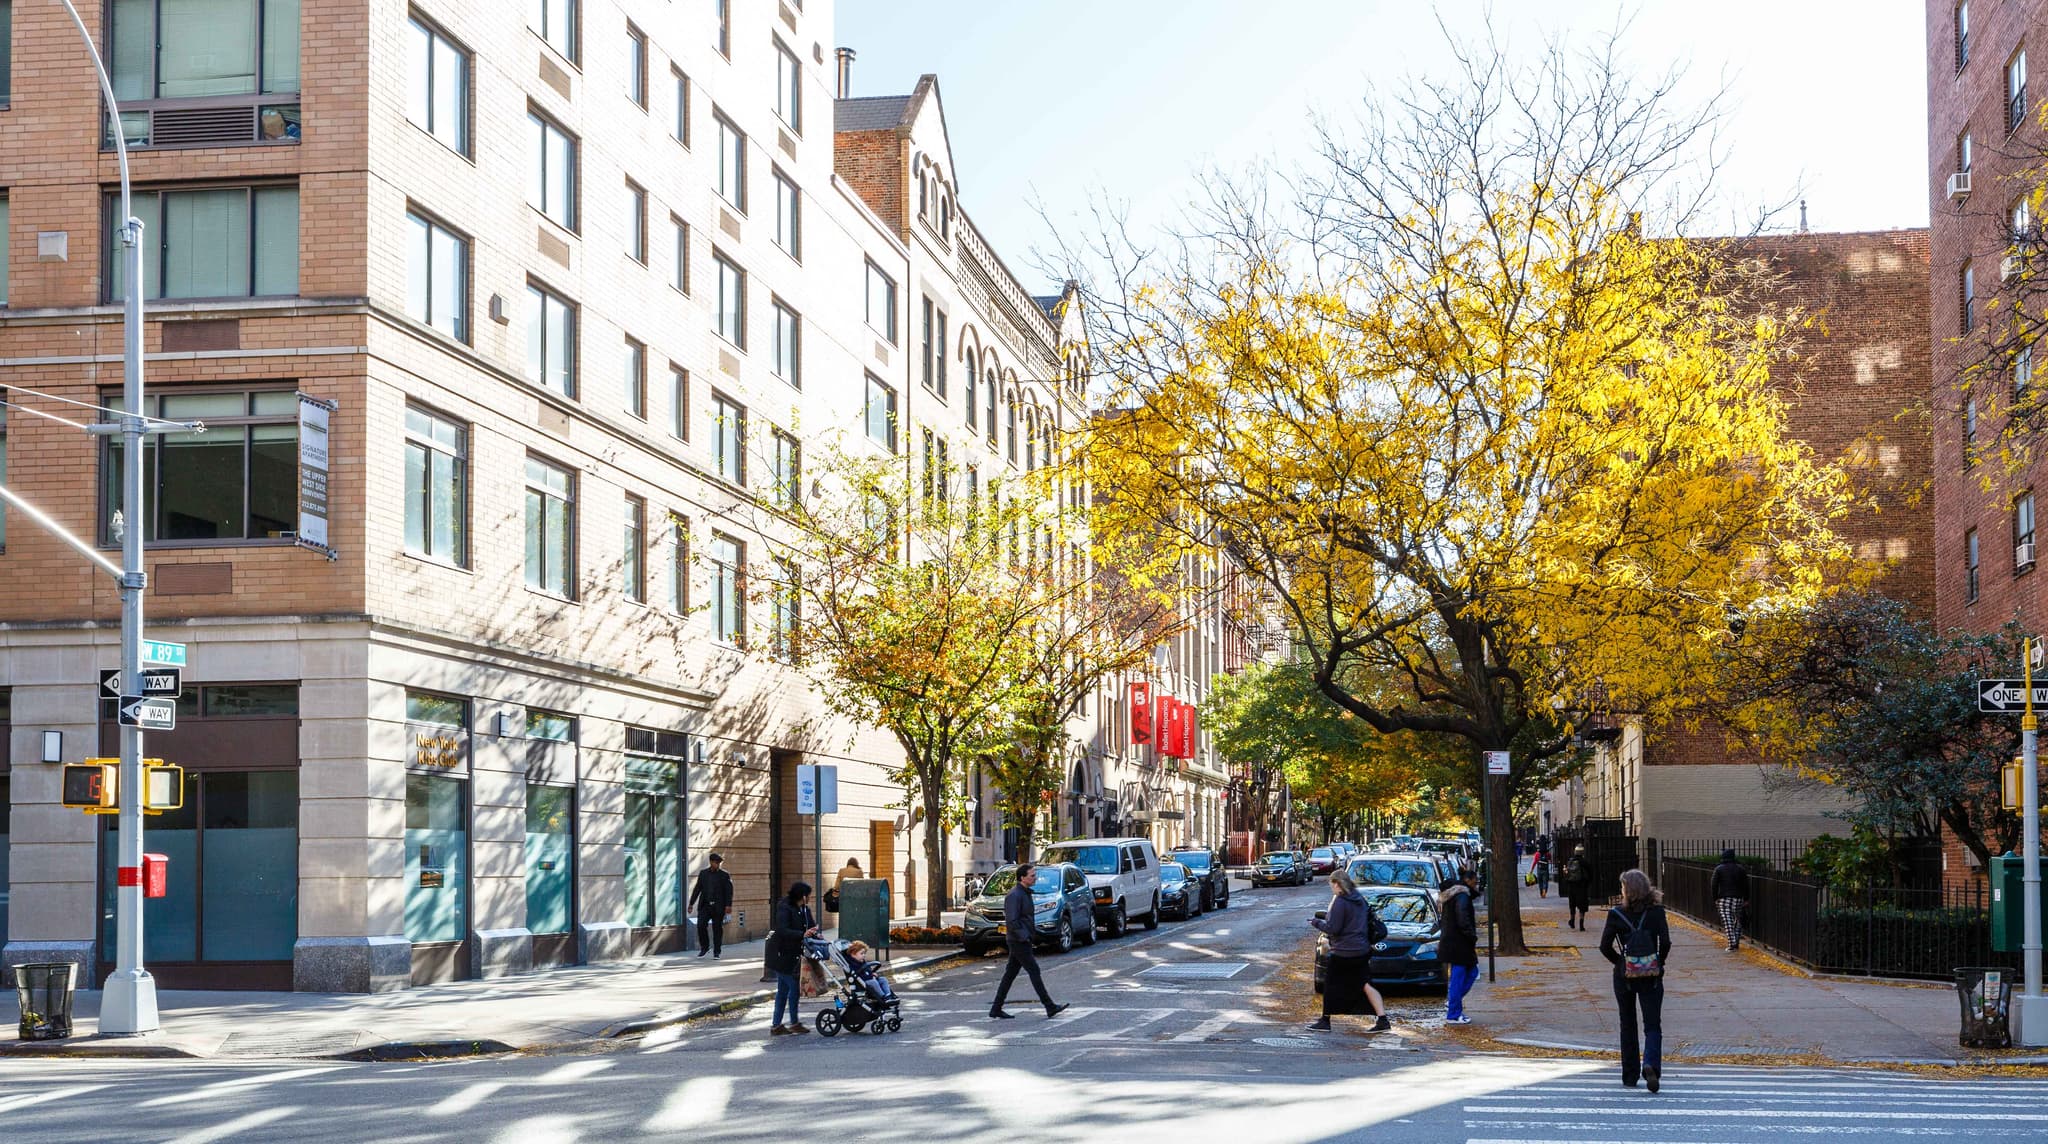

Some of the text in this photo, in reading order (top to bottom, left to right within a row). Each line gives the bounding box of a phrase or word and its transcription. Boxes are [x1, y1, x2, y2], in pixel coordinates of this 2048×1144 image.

[302, 479, 315, 488] WEST
[311, 471, 327, 483] UPPER
[143, 644, 153, 660] W
[157, 644, 172, 662] 89
[145, 677, 169, 689] WAY
[1992, 689, 2020, 702] ONE
[148, 707, 169, 720] WAY
[416, 731, 458, 752] New York
[417, 750, 458, 769] Kids Club
